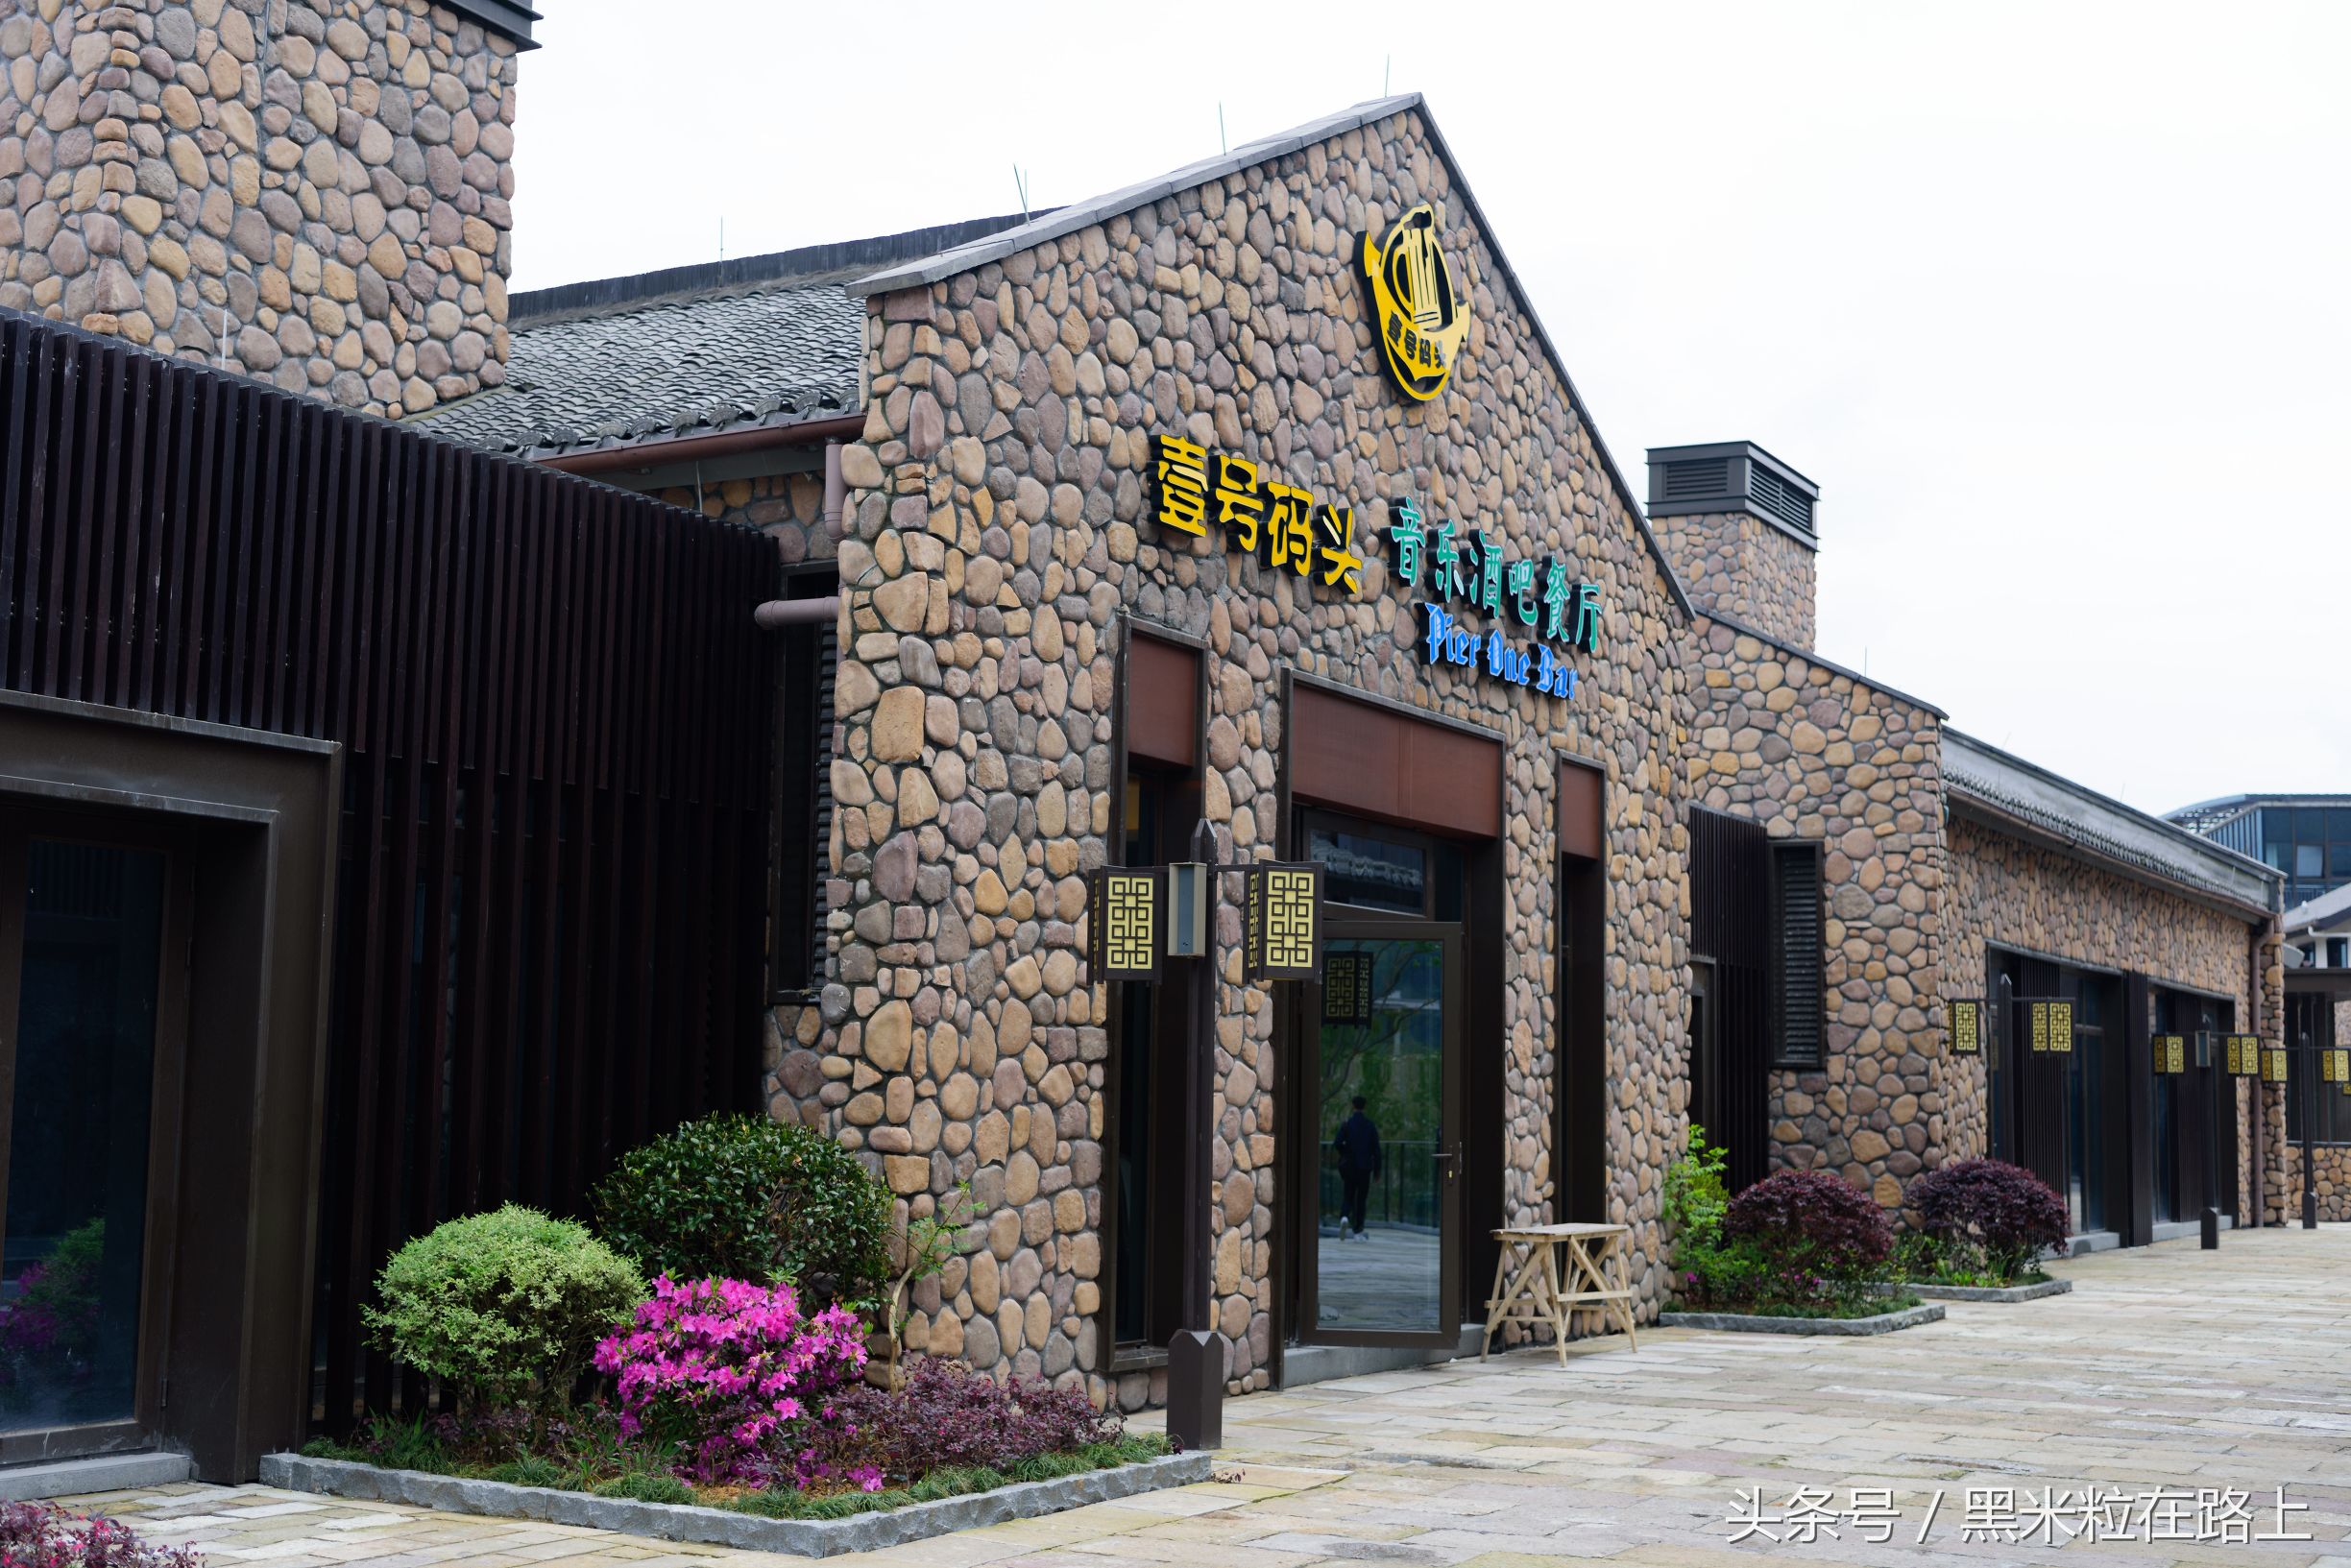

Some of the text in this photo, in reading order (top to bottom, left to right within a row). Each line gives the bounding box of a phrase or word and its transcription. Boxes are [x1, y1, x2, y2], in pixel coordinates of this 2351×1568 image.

[1157, 434, 1363, 594] 壹号码头
[1391, 495, 1602, 653] 音乐酒吧餐厅
[1425, 602, 1579, 700] Pier One Bar
